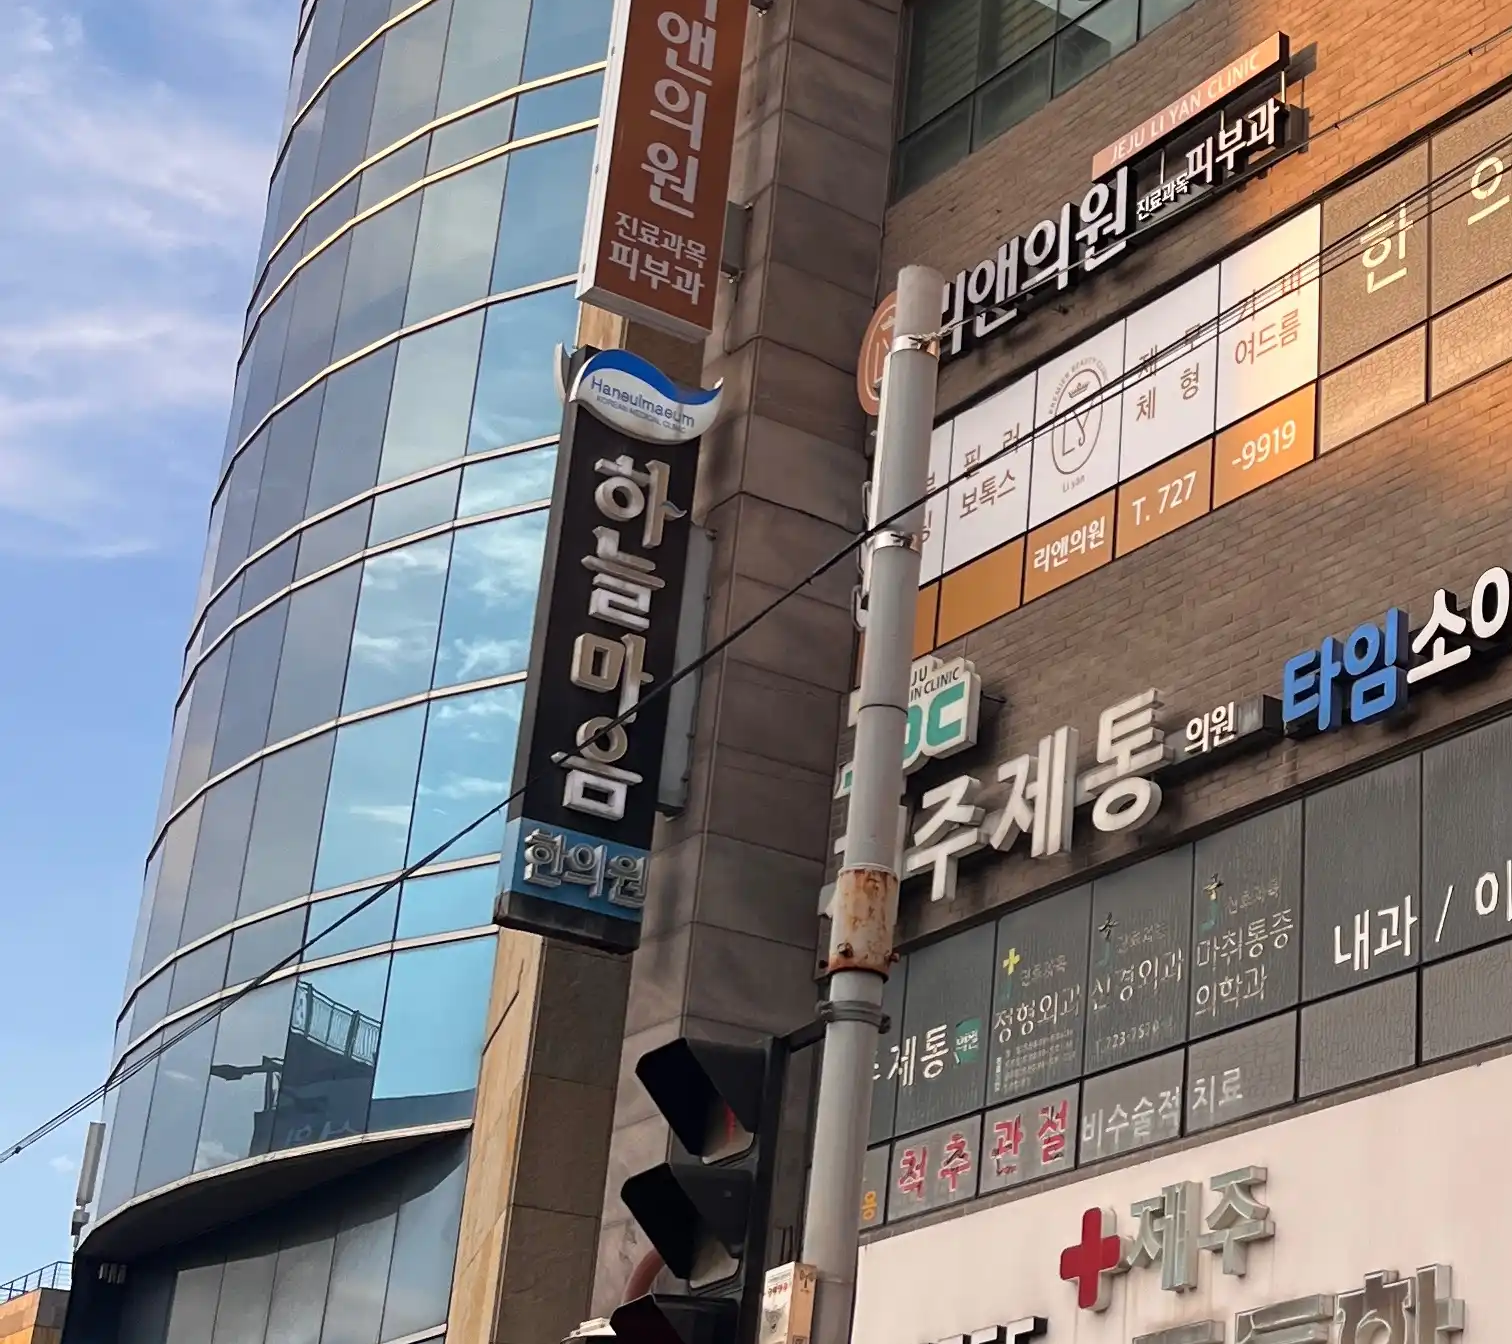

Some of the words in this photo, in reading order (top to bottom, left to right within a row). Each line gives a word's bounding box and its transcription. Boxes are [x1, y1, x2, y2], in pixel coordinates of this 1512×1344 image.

[1110, 129, 1145, 164] JEJU
[1150, 117, 1166, 139] LI
[1168, 97, 1201, 127] YAN
[1206, 52, 1261, 100] CLINIC
[1136, 173, 1190, 222] 진료과목
[1185, 97, 1281, 183] 피부과
[608, 239, 706, 307] 피부과
[614, 211, 708, 269] 진료과목
[1234, 308, 1302, 366] 여드름
[959, 468, 1016, 519] 보톡스
[1157, 470, 1198, 517] 727
[1231, 419, 1297, 472] -9919
[1033, 515, 1105, 572] 리앤의원
[550, 453, 687, 821] 하늘마음
[1281, 607, 1408, 732] 타임
[911, 664, 928, 687] JU
[923, 666, 960, 695] CLINIC
[905, 687, 1165, 902] 주제통
[1183, 701, 1236, 754] 의원
[524, 828, 650, 911] 한의원
[1195, 908, 1294, 972] 마취통증
[1333, 894, 1418, 972] 내과
[1090, 947, 1185, 1011] 신경외과
[1194, 963, 1268, 1017] 의학과
[994, 983, 1082, 1044] 정형외과
[1082, 1085, 1182, 1149] 비수술적
[1191, 1067, 1244, 1114] 치료
[1125, 1164, 1276, 1293] 제주
